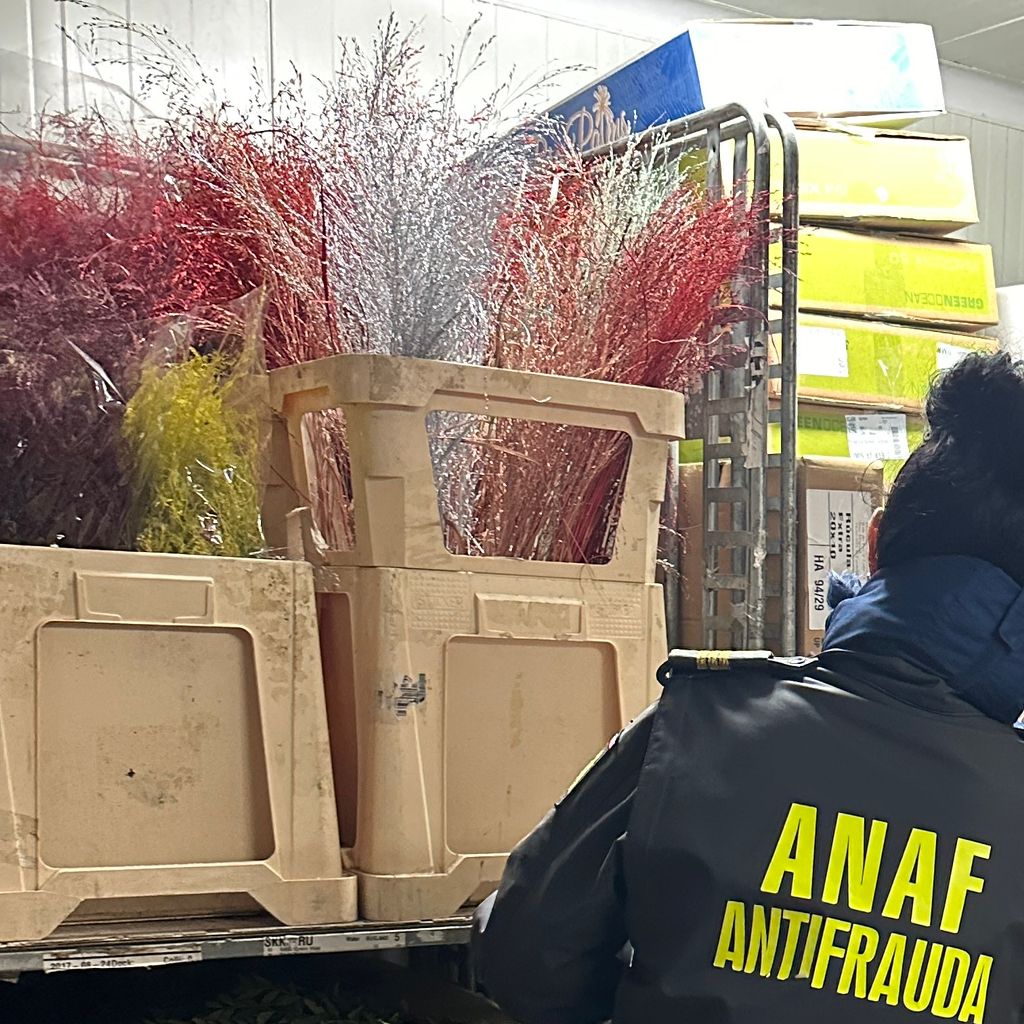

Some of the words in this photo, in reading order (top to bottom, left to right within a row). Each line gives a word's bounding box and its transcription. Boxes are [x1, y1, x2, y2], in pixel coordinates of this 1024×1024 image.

[903, 291, 984, 310] GREENOCEAN
[814, 554, 824, 572] HA
[814, 579, 825, 611] 94/29
[760, 802, 991, 934] ANAF
[298, 934, 314, 947] RU
[713, 900, 994, 1024] ANTIFRAUDA
